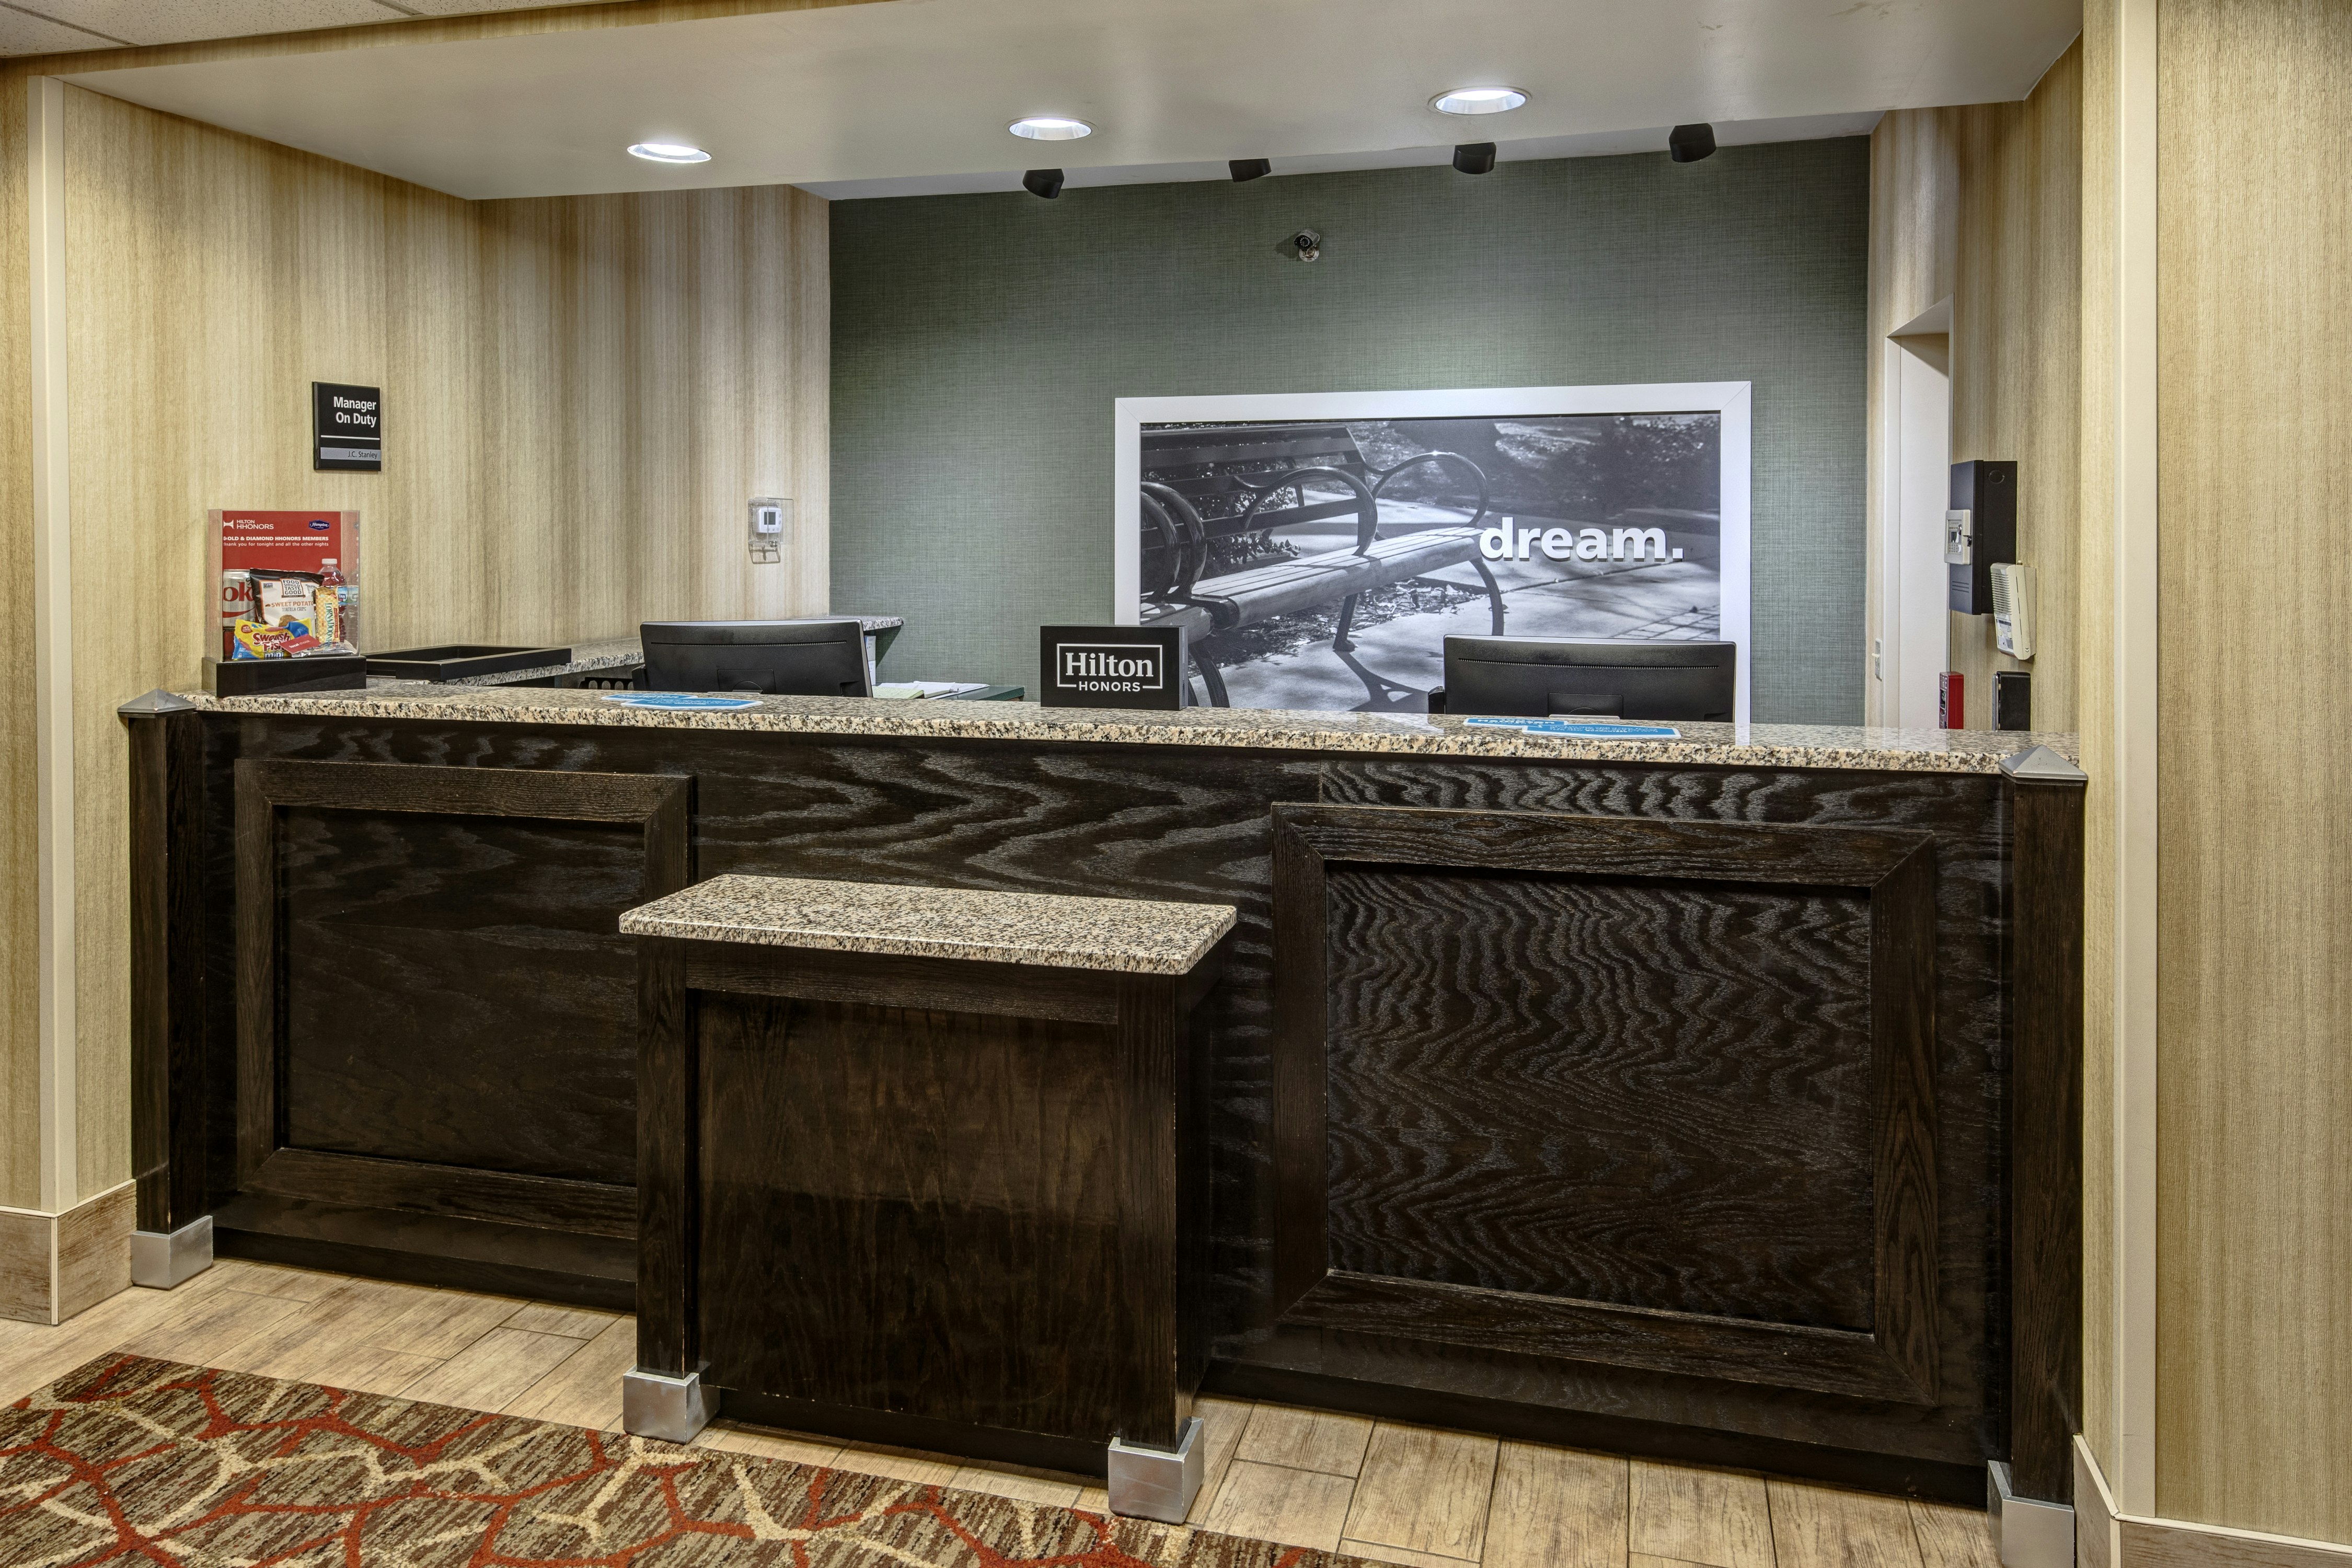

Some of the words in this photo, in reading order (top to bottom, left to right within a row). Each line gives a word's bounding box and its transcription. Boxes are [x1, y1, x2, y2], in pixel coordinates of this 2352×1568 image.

[333, 396, 377, 412] Manager
[336, 412, 350, 424] On
[353, 413, 377, 428] Duty
[359, 451, 378, 459] Stanley
[1479, 516, 1684, 562] dream.
[224, 582, 255, 602] ok
[1065, 652, 1154, 677] Hilton
[1079, 681, 1140, 691] HONORS
